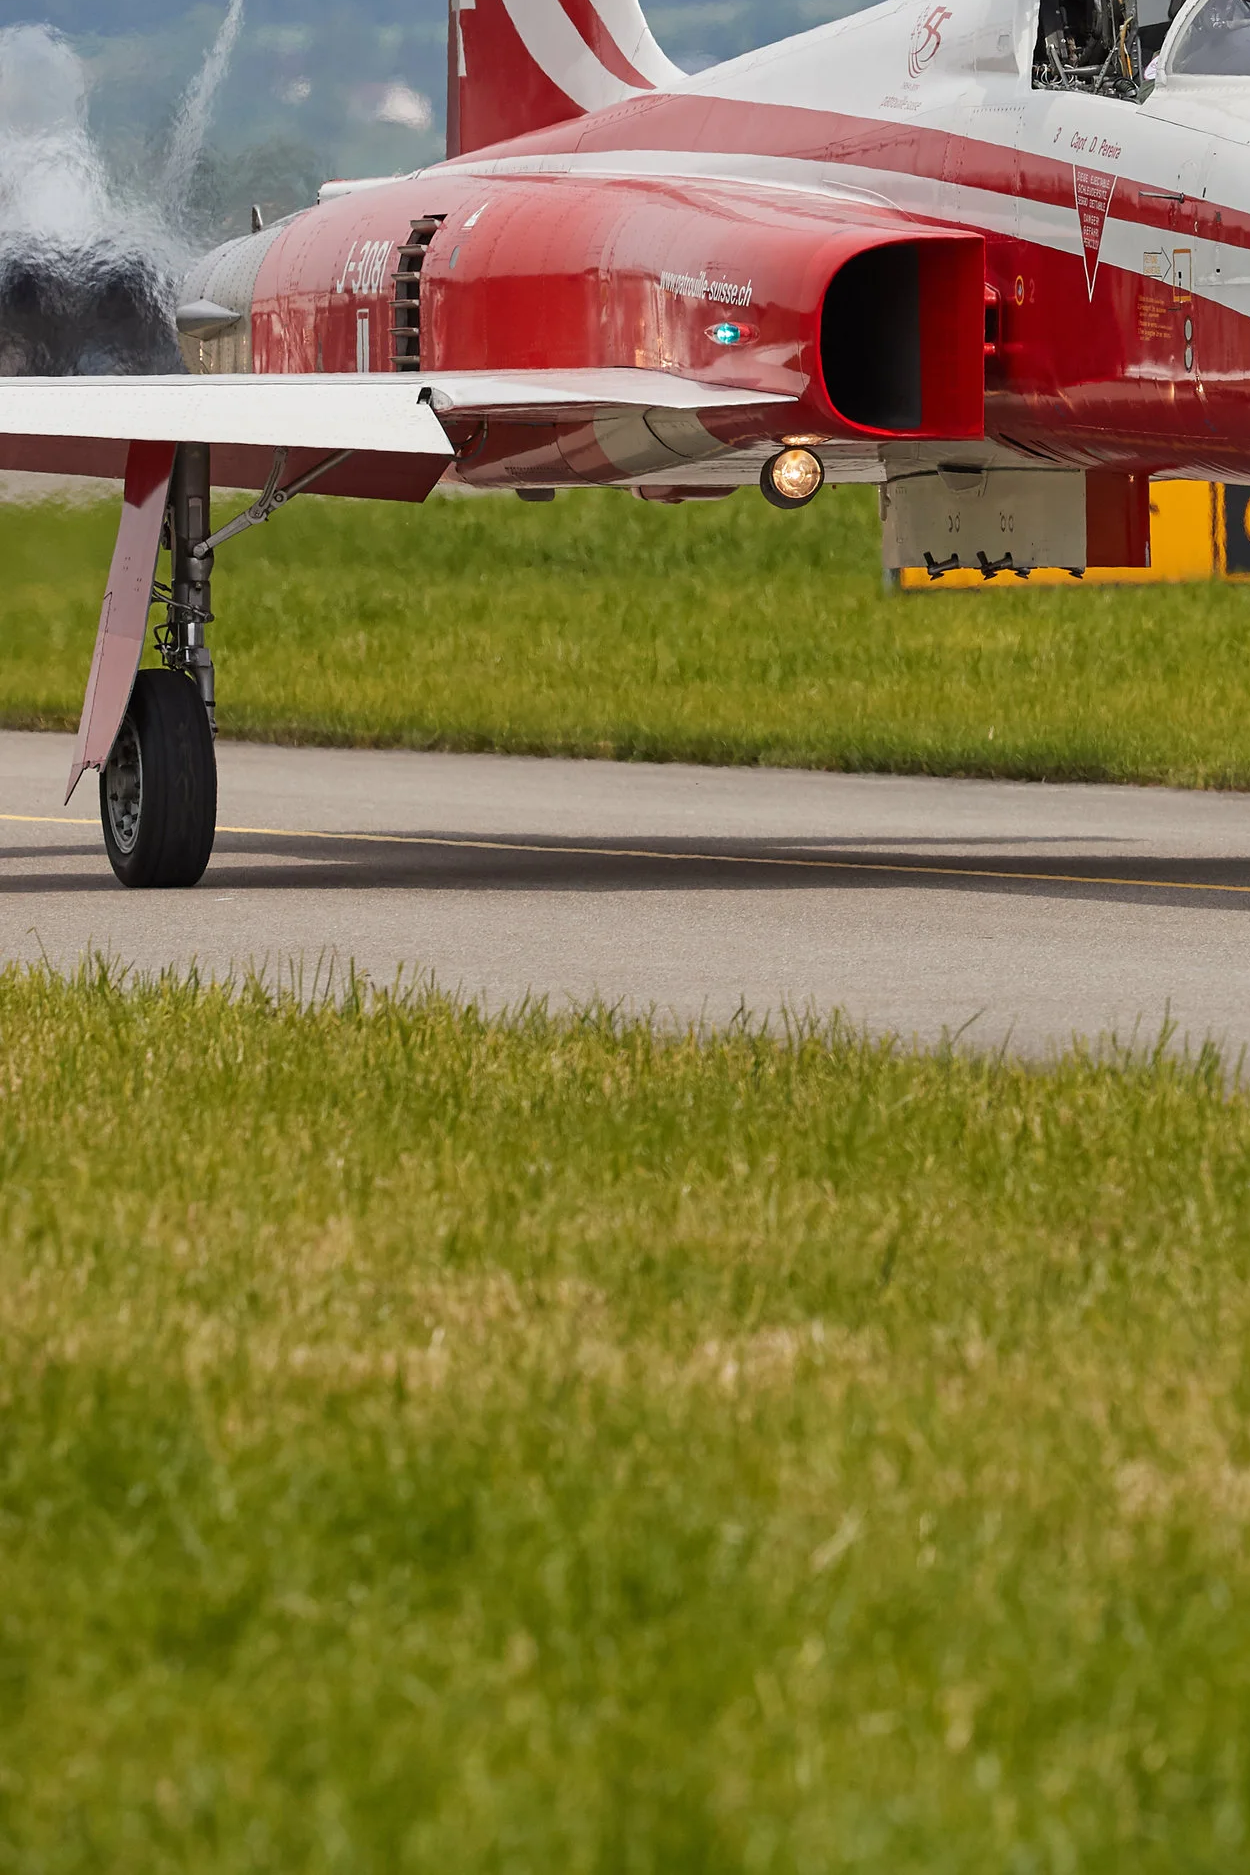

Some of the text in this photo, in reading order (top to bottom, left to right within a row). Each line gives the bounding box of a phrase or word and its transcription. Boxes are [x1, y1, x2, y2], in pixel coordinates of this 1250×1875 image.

[1053, 126, 1121, 159] 3 Capt D. Pereira
[336, 240, 395, 295] J-3081
[660, 270, 753, 307] www.patrouille-suisse.ch
